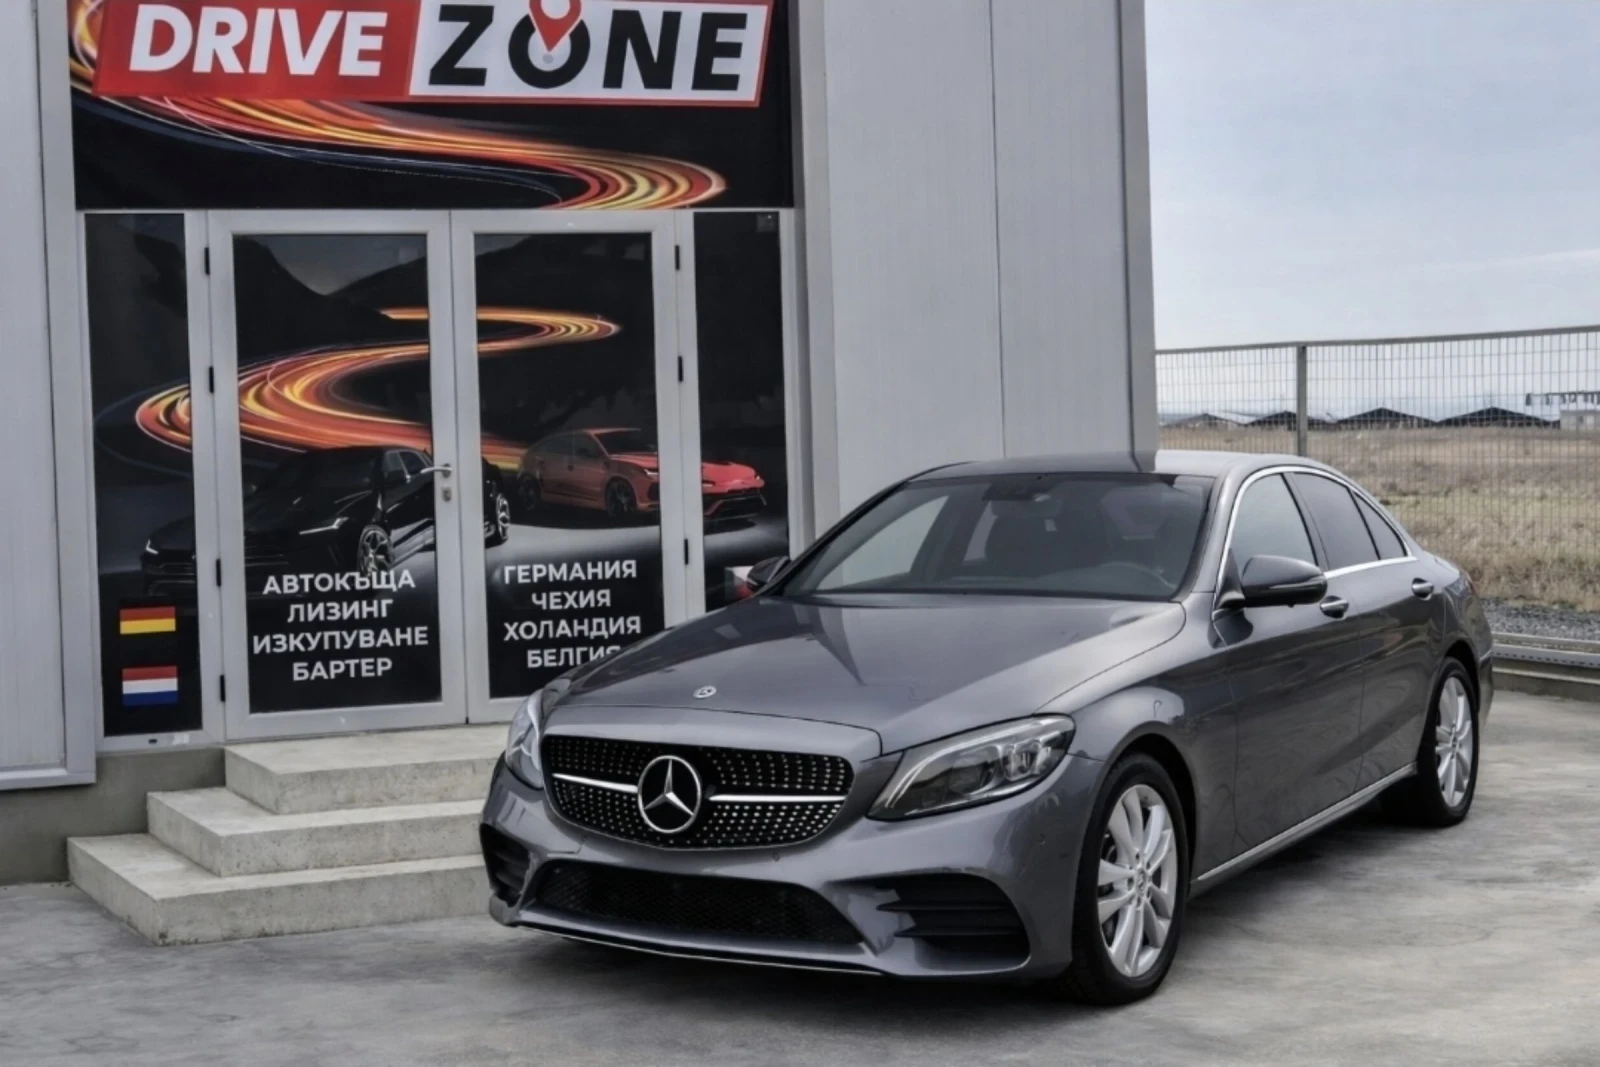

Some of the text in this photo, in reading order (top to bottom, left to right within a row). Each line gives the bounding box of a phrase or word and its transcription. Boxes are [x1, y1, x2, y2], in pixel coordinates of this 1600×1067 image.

[129, 4, 748, 90] DRIVE ZONE
[262, 569, 416, 595] АВТОКЪЩА
[504, 560, 637, 584] ГЕРМАНИЯ
[287, 599, 393, 623] ЛИЗИНГ
[531, 589, 611, 610] ЧЕХИЯ
[253, 626, 429, 654] ИЗКУПУВАНЕ
[503, 616, 641, 641] ХОЛАНДИЯ
[292, 658, 392, 681] БАРТЕР
